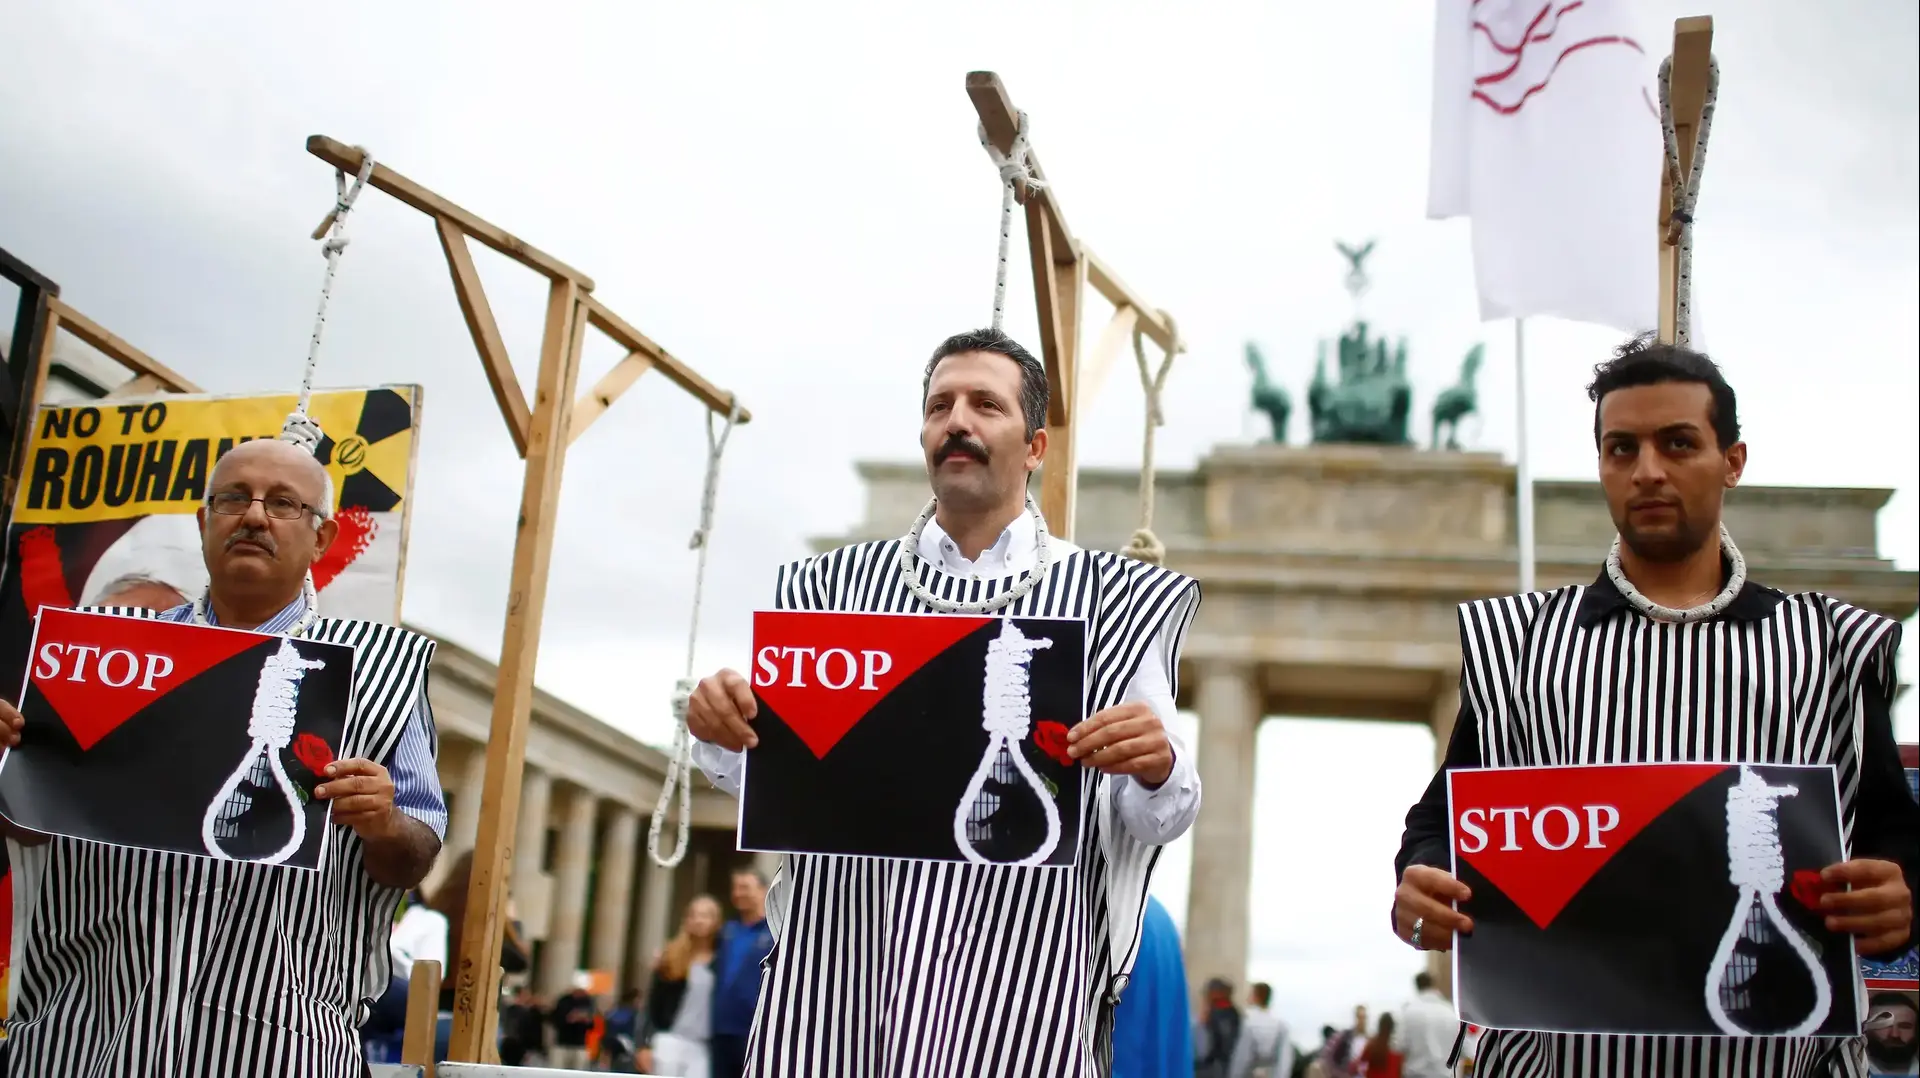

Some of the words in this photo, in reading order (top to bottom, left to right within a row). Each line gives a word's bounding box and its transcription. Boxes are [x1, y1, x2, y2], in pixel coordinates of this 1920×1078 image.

[41, 407, 101, 439] NO
[117, 402, 167, 436] TO
[26, 435, 274, 510] ROUHA
[35, 642, 174, 691] STOP
[755, 646, 893, 691] STOP
[1459, 805, 1620, 853] STOP
